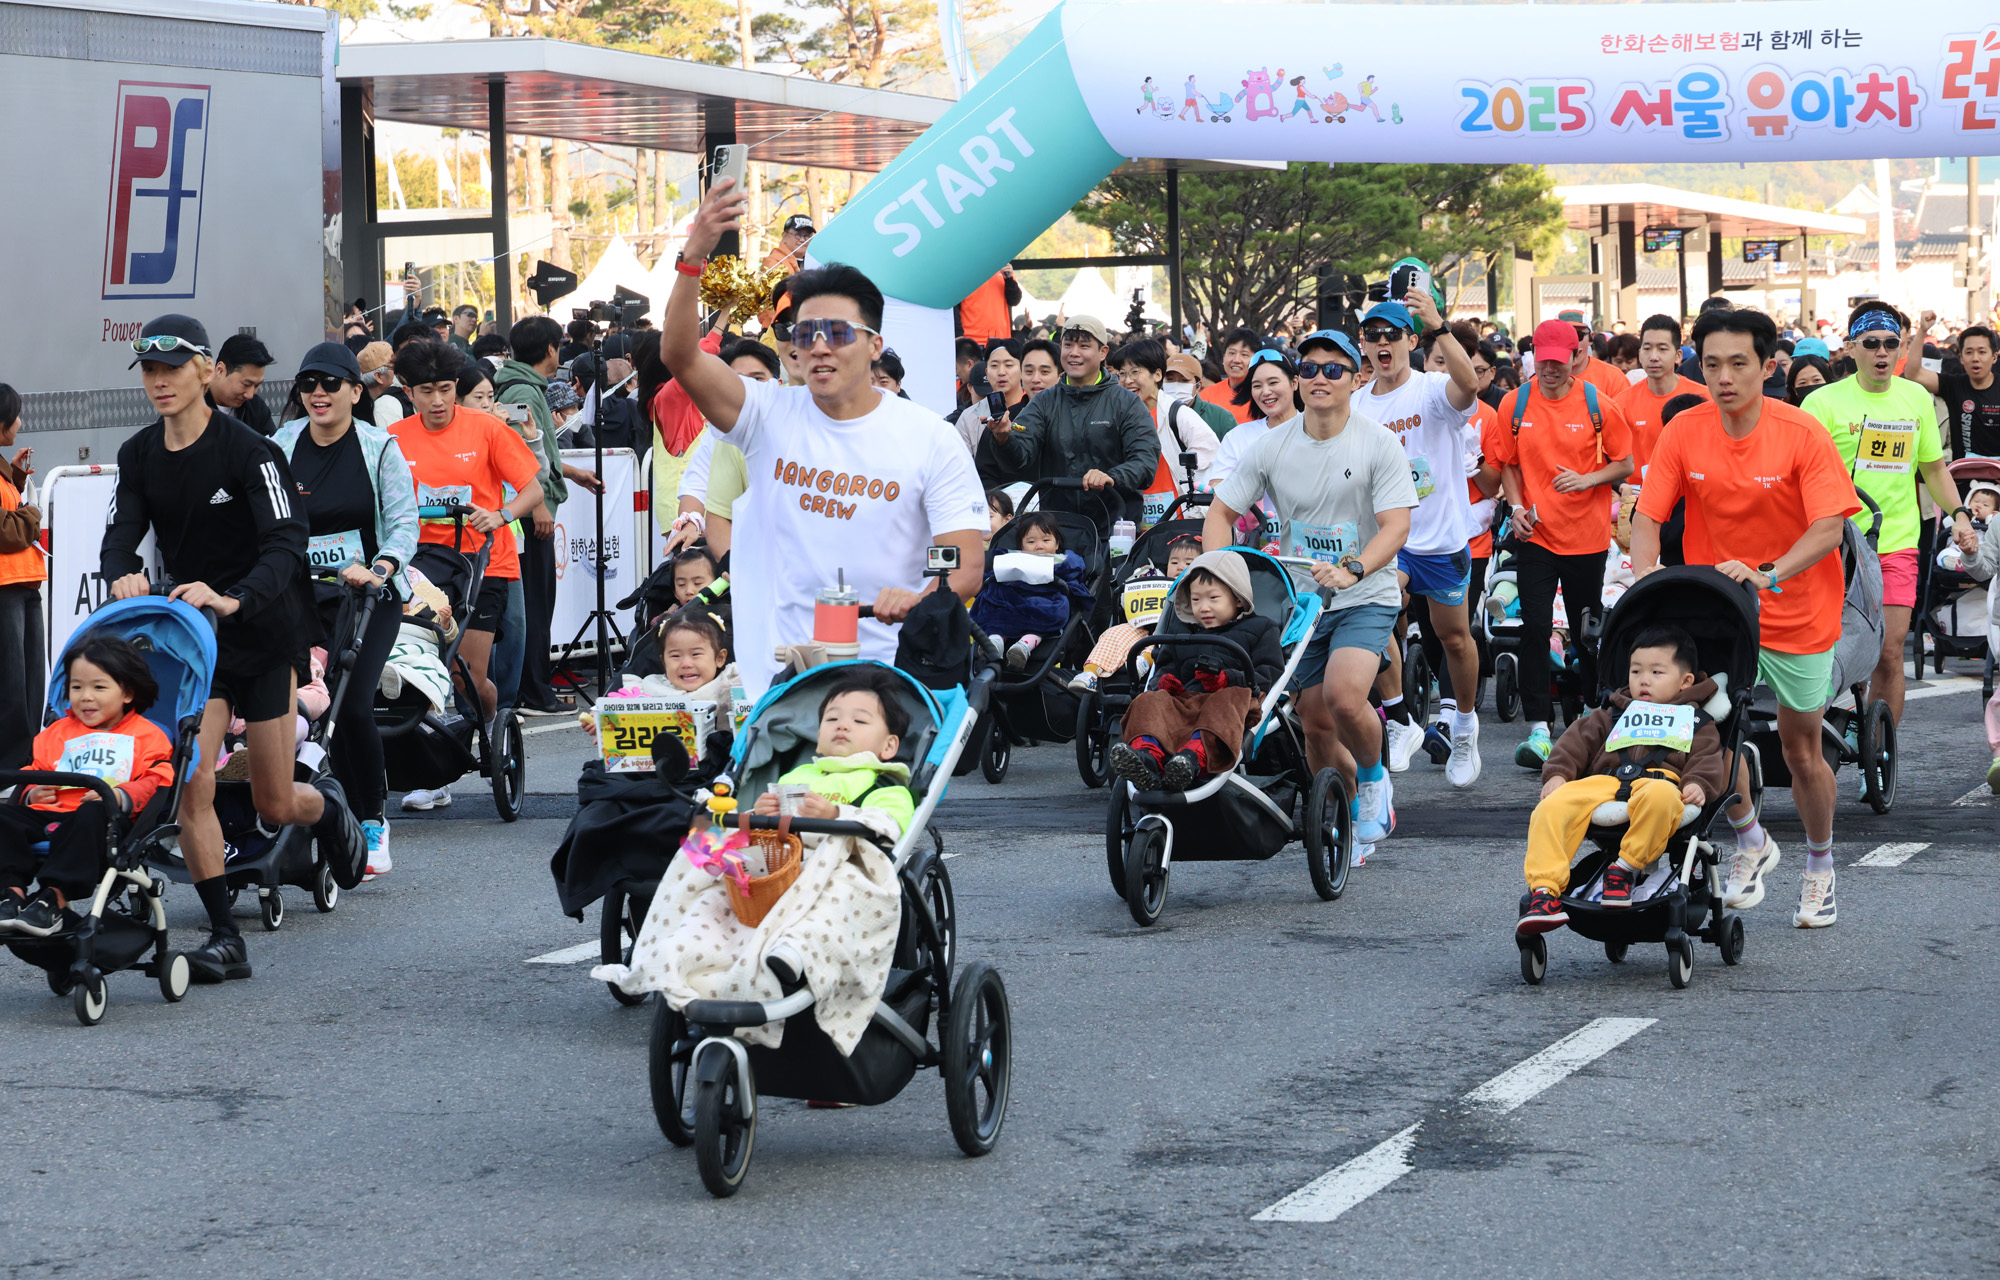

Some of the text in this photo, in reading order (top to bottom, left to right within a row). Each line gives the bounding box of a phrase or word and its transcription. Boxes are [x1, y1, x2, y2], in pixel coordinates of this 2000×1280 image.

[1600, 28, 1864, 55] 한화손해보험과 함께 하는
[1460, 85, 1587, 132] 2025
[1609, 71, 1726, 139] 서울
[1746, 71, 1920, 137] 유아차
[873, 106, 1036, 258] START
[102, 318, 143, 343] Power
[799, 493, 858, 521] CREW
[570, 535, 620, 563] 한화손보험
[1305, 535, 1343, 552] 10411
[603, 702, 687, 712] 아이와 함께 달리고 있어요
[1623, 713, 1675, 728] 10187
[1635, 728, 1661, 738] 토끼반
[68, 747, 117, 773] 10945
